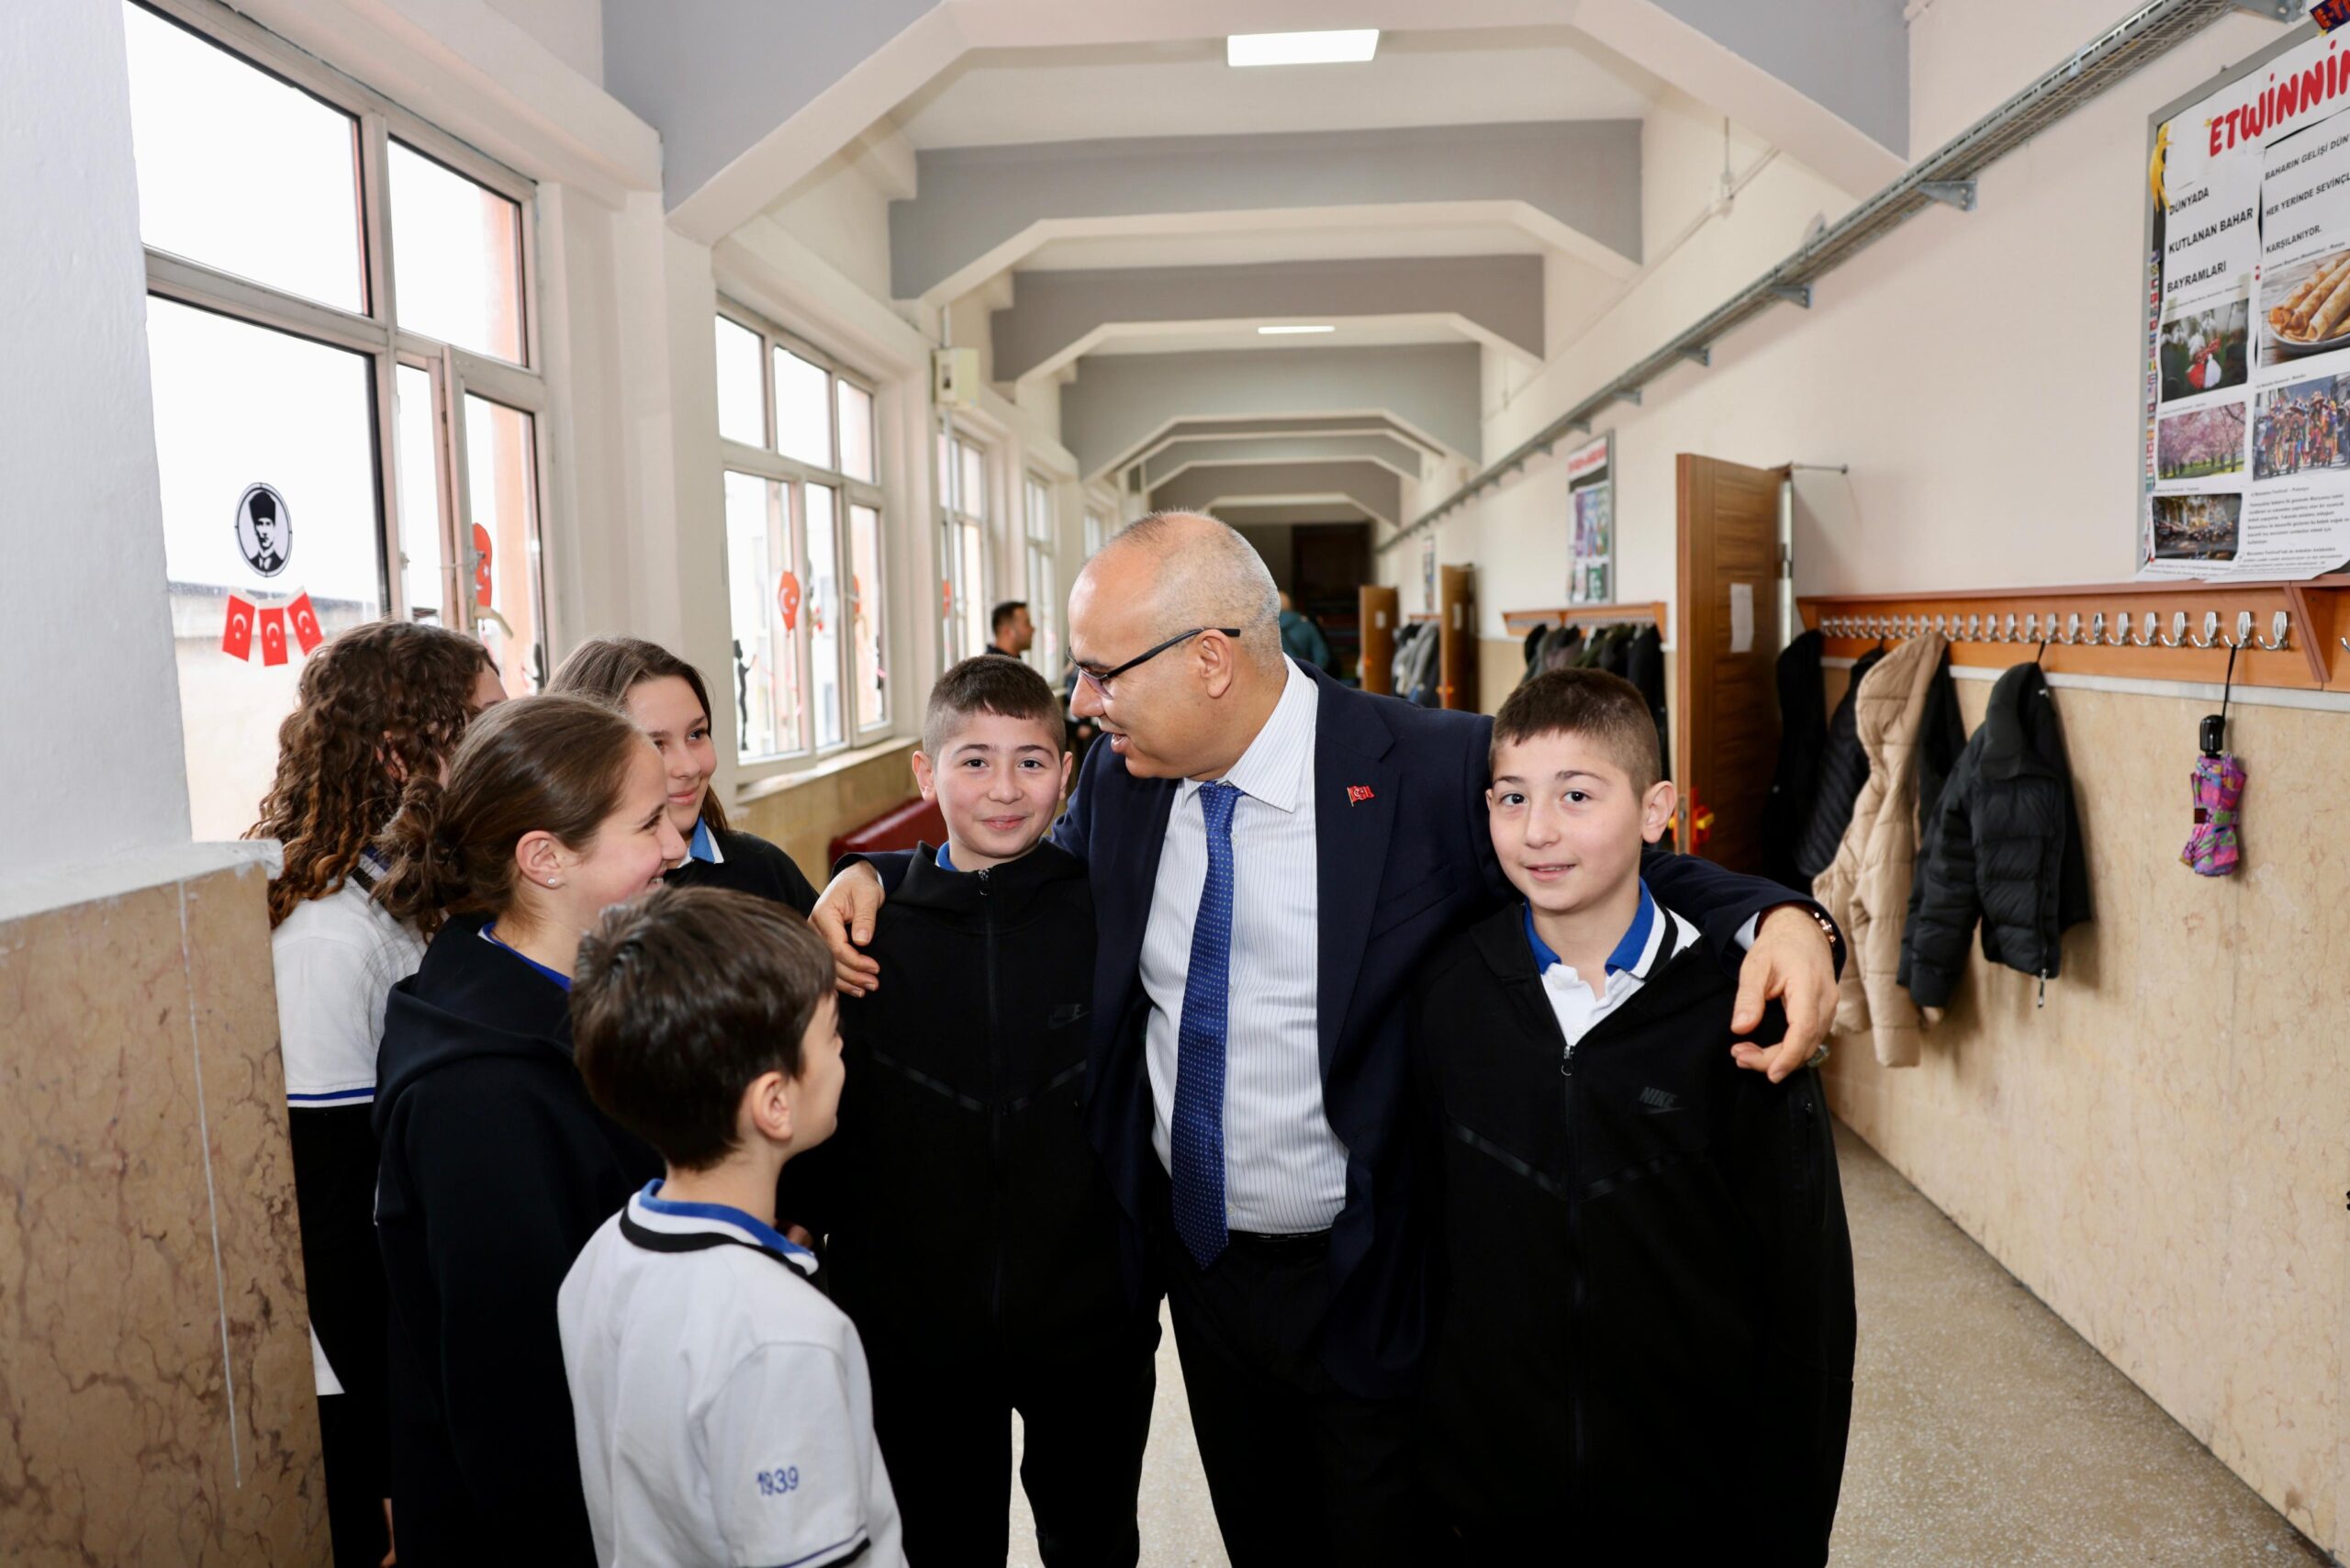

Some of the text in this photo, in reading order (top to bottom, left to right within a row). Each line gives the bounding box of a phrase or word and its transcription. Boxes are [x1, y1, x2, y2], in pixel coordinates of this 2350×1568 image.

[2265, 157, 2300, 181] BAHARIN
[2330, 133, 2350, 150] DÜN
[2168, 186, 2210, 216] DÜNYADA
[2266, 204, 2279, 217] HER
[2281, 187, 2314, 209] YERİNDE
[2168, 207, 2254, 254] KUTLANAN BAHAR
[2166, 260, 2227, 293] BAYRAMLARI
[1639, 1086, 1678, 1108] NIKE
[756, 1465, 799, 1496] 1939
